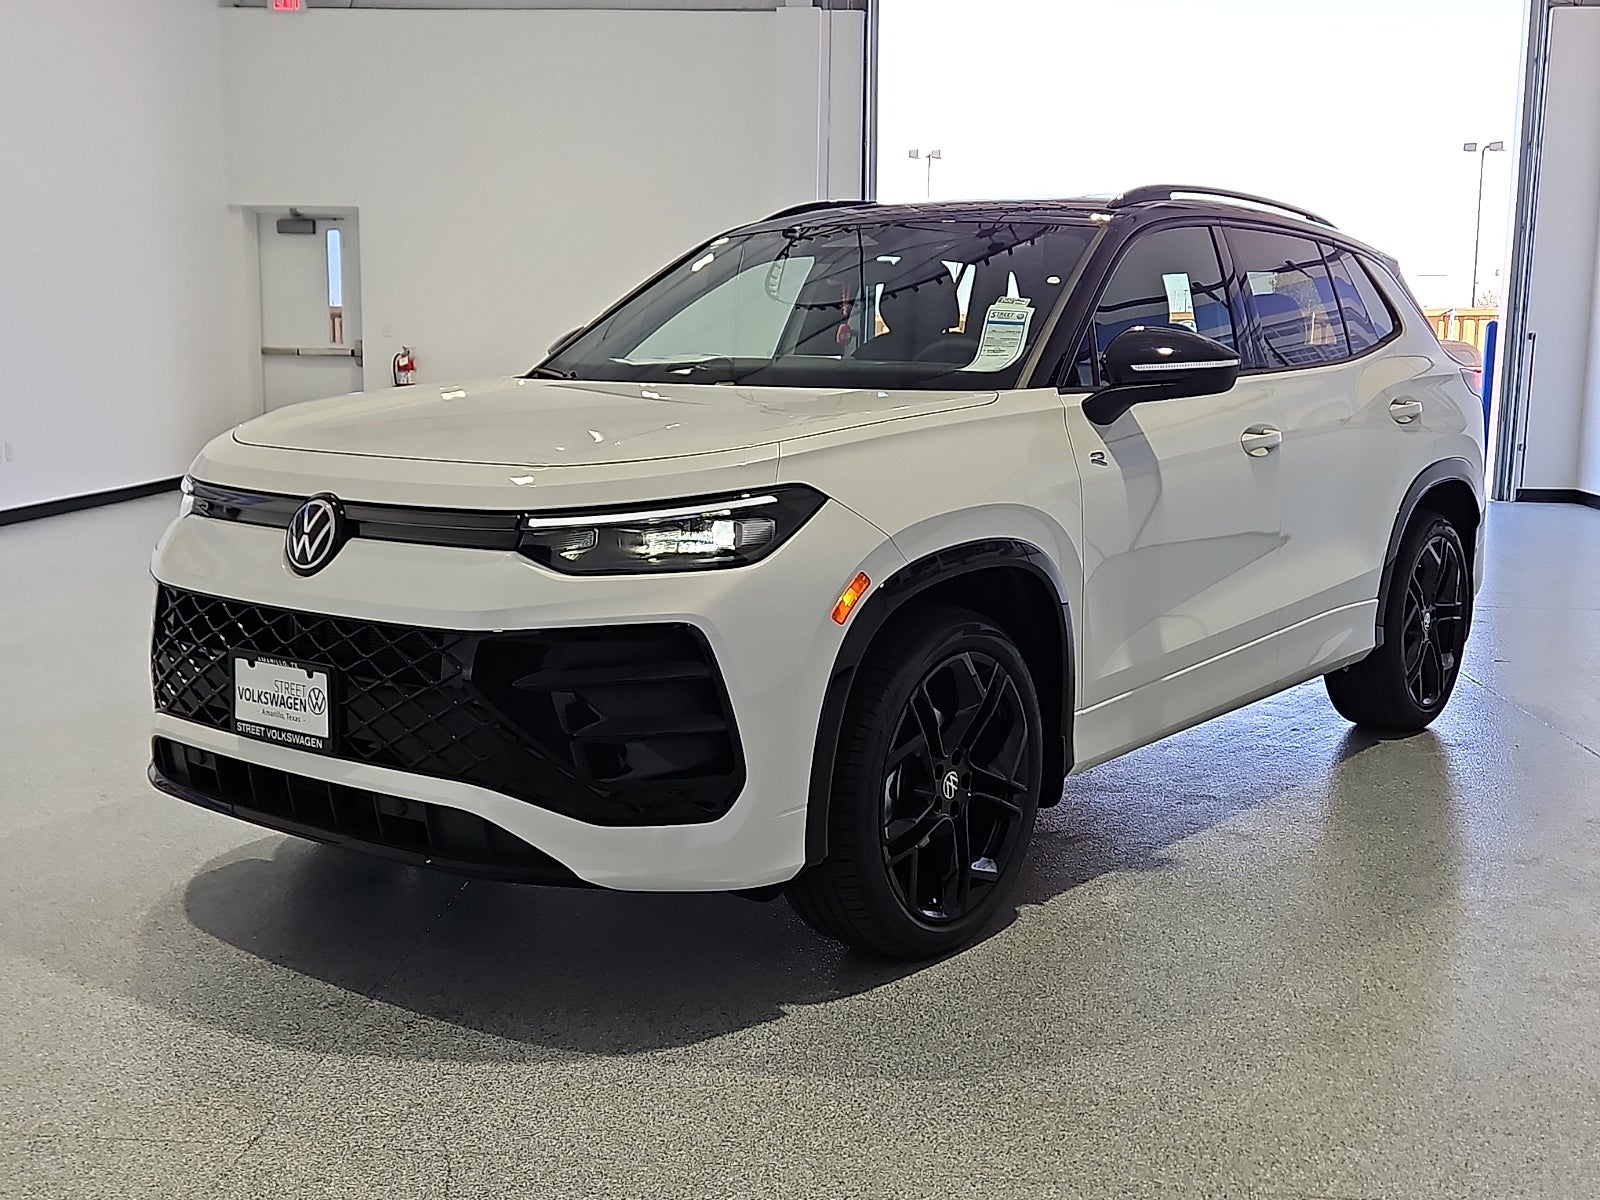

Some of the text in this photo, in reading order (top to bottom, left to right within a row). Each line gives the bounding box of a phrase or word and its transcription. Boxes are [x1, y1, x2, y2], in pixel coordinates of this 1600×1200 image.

[237, 685, 307, 713] VOLKSWAGEN
[274, 679, 307, 698] STREET
[286, 712, 301, 723] Texas
[236, 721, 323, 749] STREET VOLKSWAGEN
